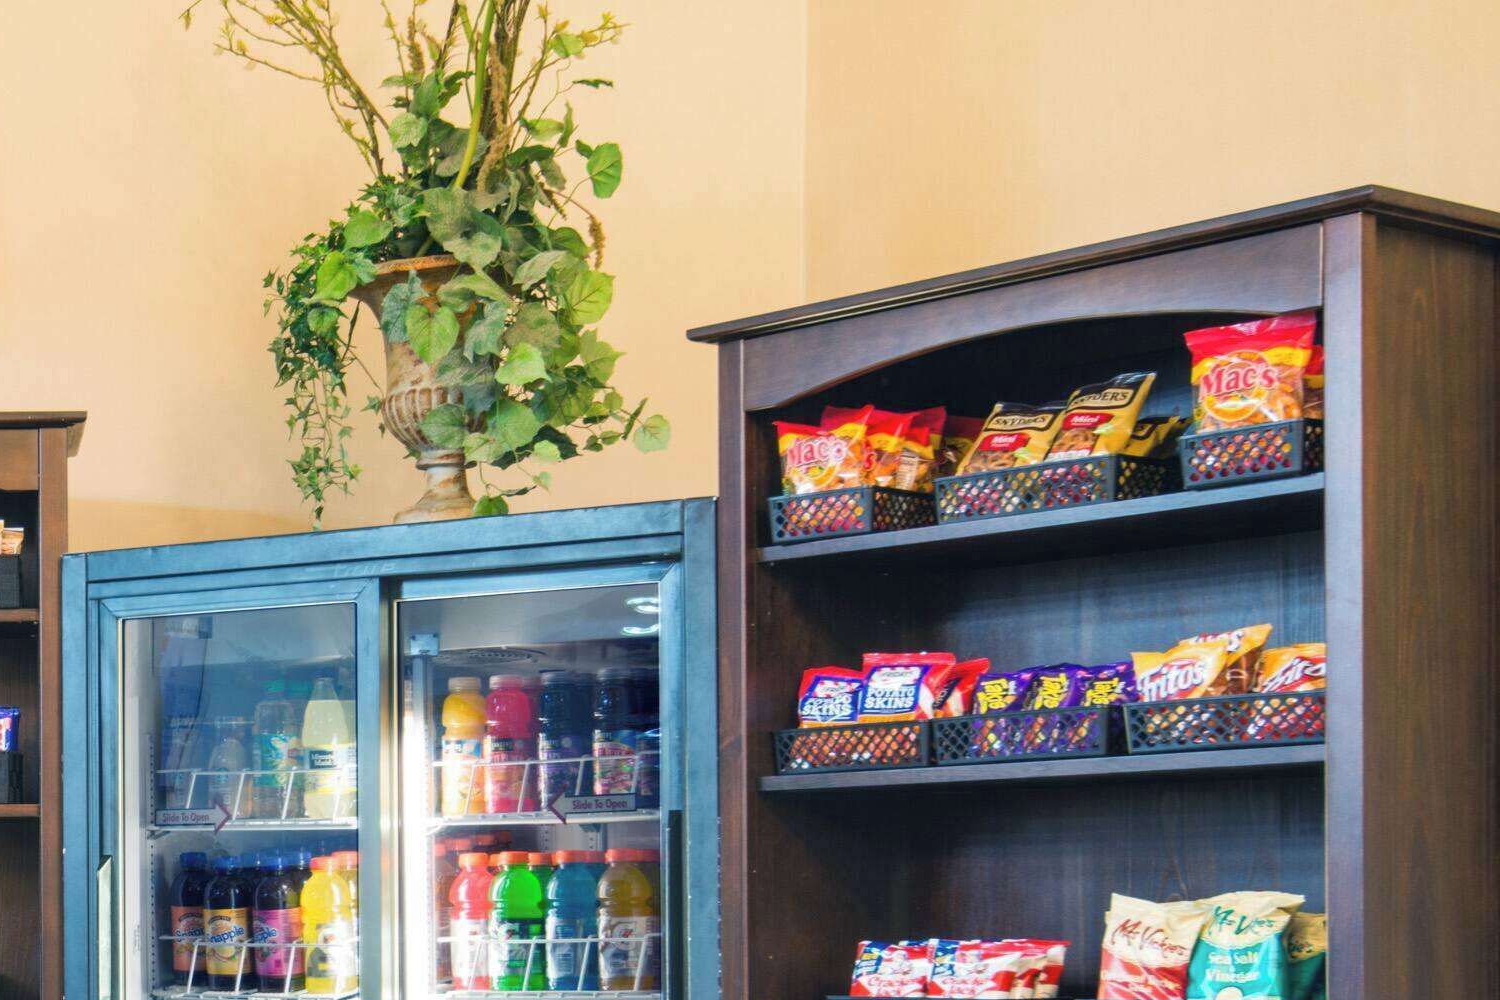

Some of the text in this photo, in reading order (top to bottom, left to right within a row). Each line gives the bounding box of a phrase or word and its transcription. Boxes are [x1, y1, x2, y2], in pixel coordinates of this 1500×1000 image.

[1202, 363, 1278, 396] Mac's
[1137, 663, 1206, 702] Fritos
[867, 688, 916, 698] POTATO
[864, 696, 915, 709] SKINS
[801, 703, 852, 716] SKINS
[572, 799, 592, 810] Slide
[606, 799, 628, 809] Open
[163, 813, 180, 823] Slide
[189, 813, 210, 823] Open
